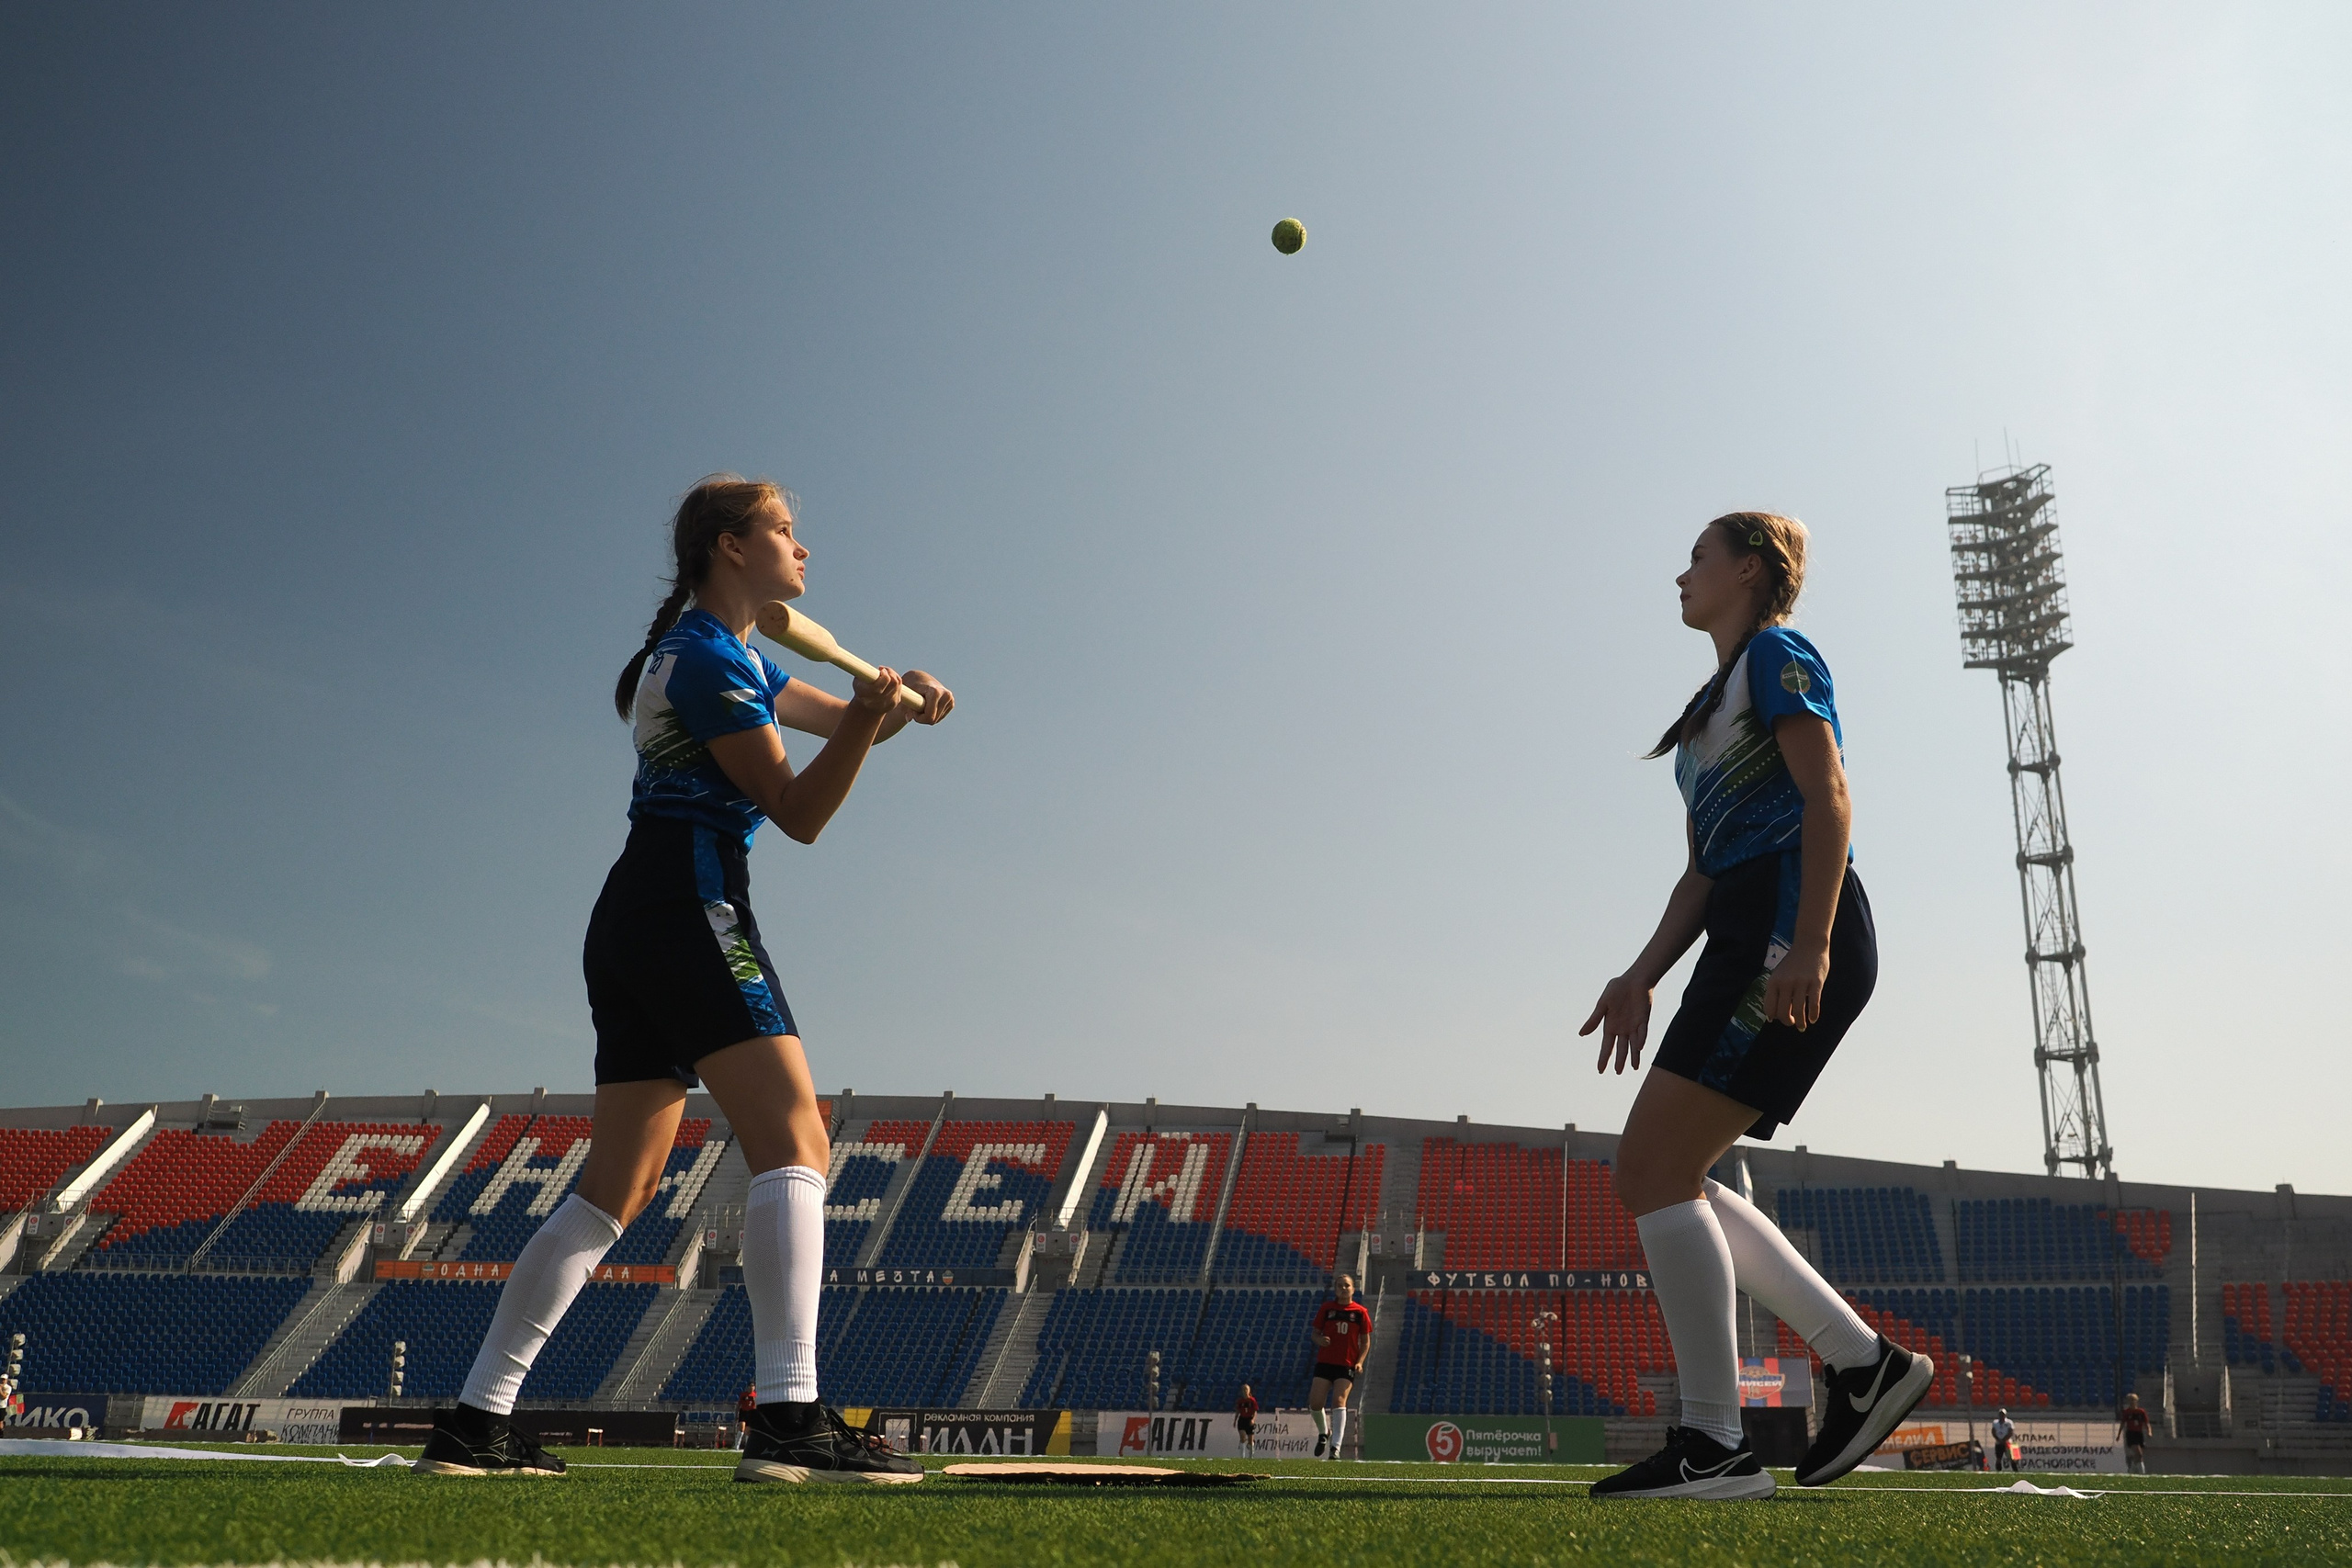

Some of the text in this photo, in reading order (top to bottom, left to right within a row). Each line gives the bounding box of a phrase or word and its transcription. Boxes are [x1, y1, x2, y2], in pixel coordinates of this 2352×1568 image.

[440, 1263, 499, 1277] ОДНА
[1427, 1272, 1647, 1287] ФУТБОЛ ПО-НОВ
[1336, 1322, 1348, 1335] 10
[191, 1403, 261, 1431] АГАТ
[287, 1408, 334, 1420] ГРУППА
[923, 1413, 1035, 1423] рекламная компания
[280, 1424, 340, 1440] КОМПАНИ
[1151, 1417, 1213, 1451] АГАТ
[1254, 1424, 1289, 1434] УППА
[1465, 1429, 1542, 1443] Пятёрочка
[1254, 1438, 1309, 1451] МПАНИЙ
[2014, 1433, 2056, 1442] КЛАМА
[1466, 1445, 1542, 1462] выручает!
[1910, 1443, 1970, 1466] СЕРВИС
[2018, 1458, 2096, 1469] РАСНОЯРСКЕ
